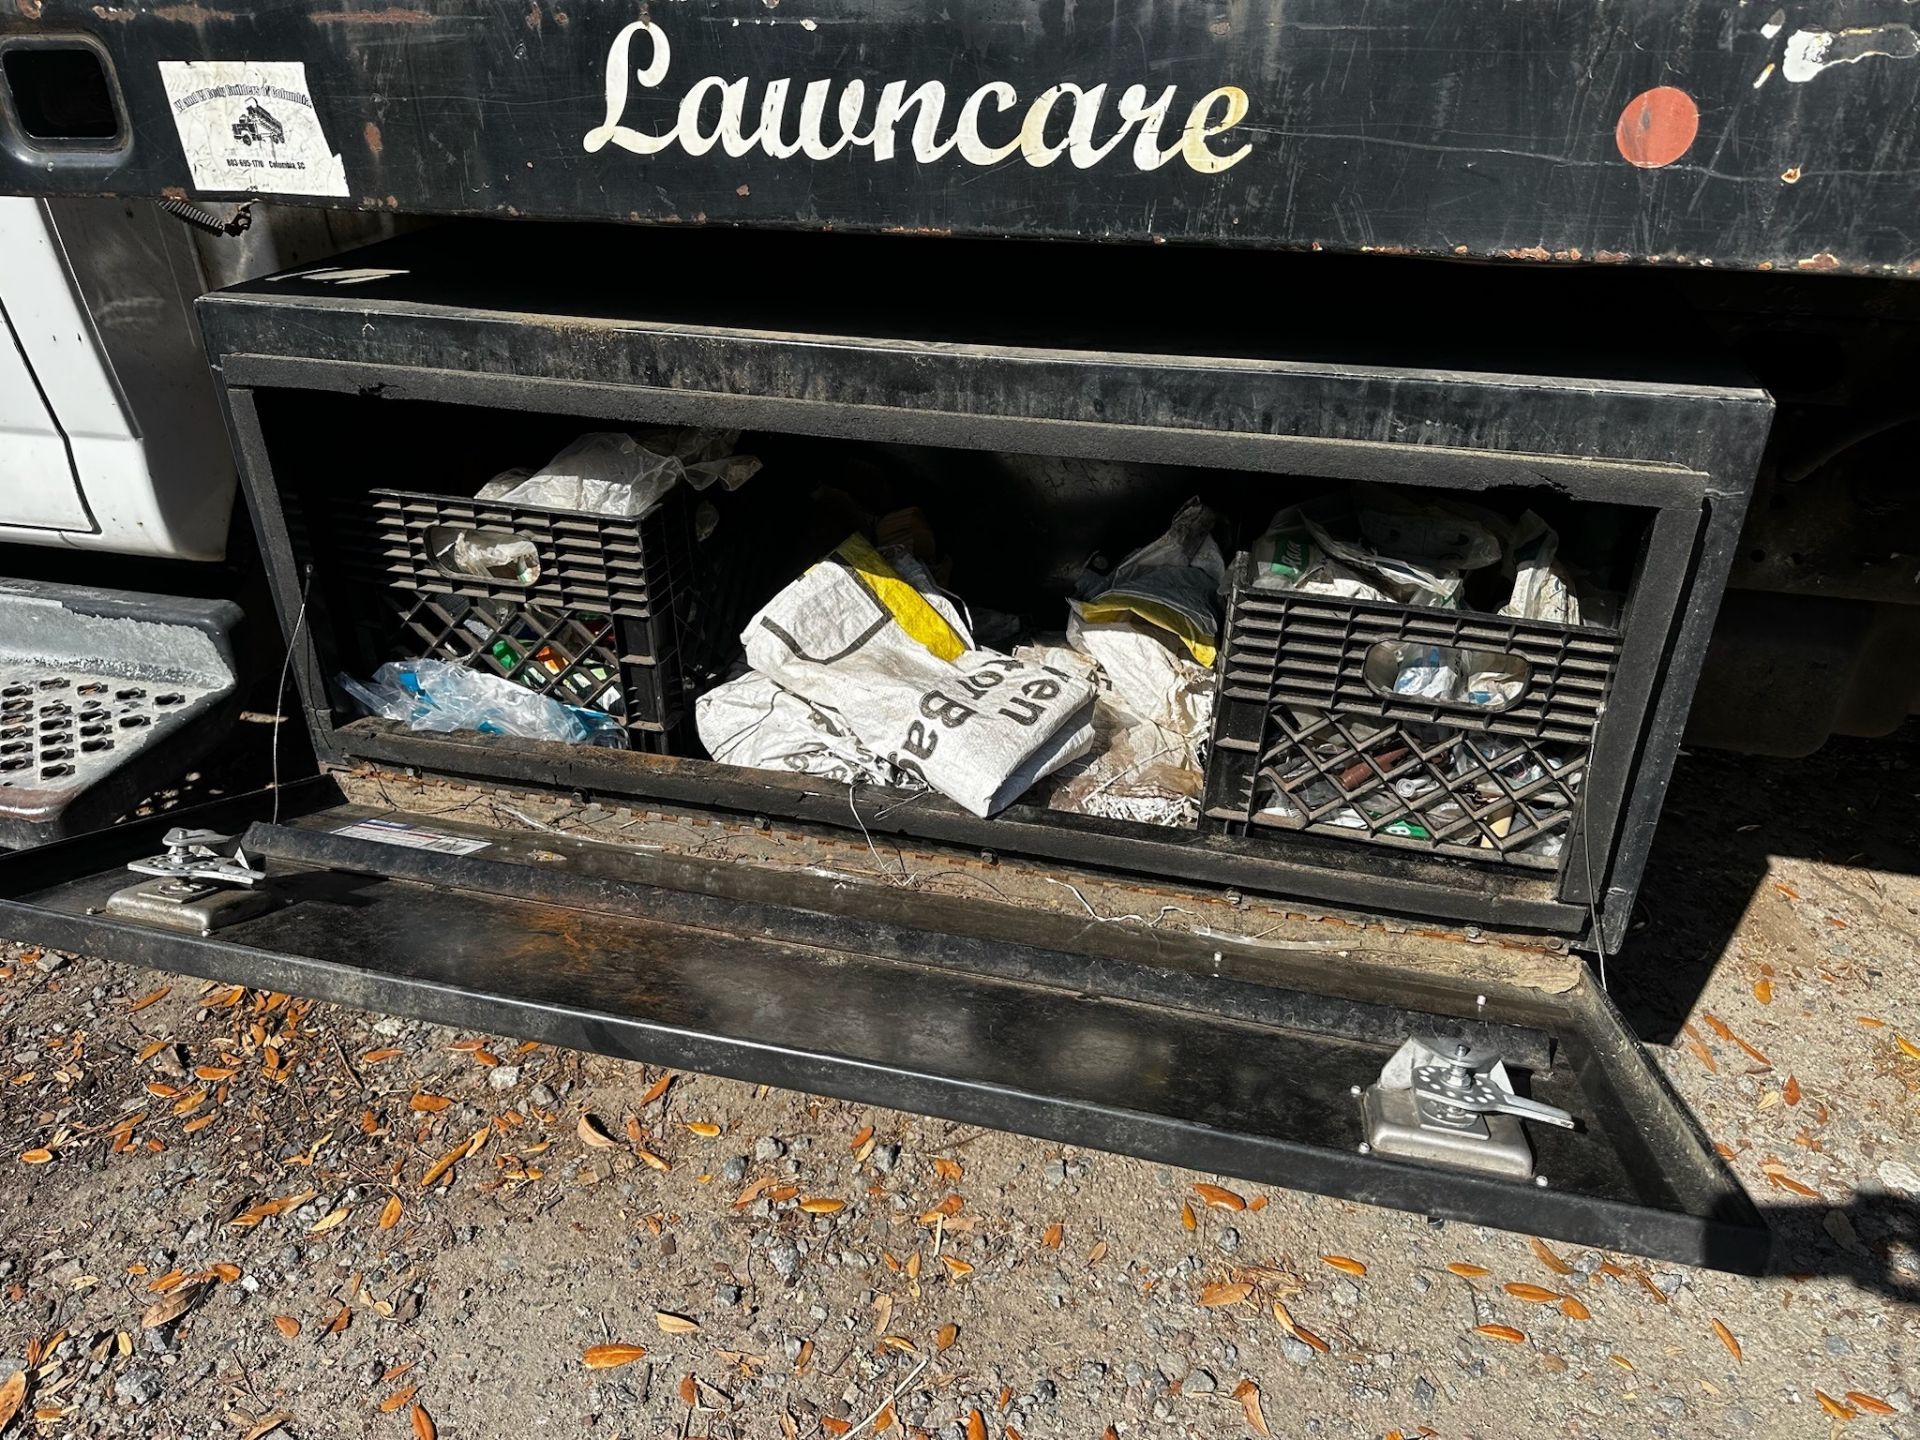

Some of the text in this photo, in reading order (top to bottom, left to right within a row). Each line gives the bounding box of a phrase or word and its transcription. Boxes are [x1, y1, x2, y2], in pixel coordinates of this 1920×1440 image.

[205, 85, 227, 99] Body
[225, 84, 260, 96] Builders
[583, 20, 1253, 174] Lawncare
